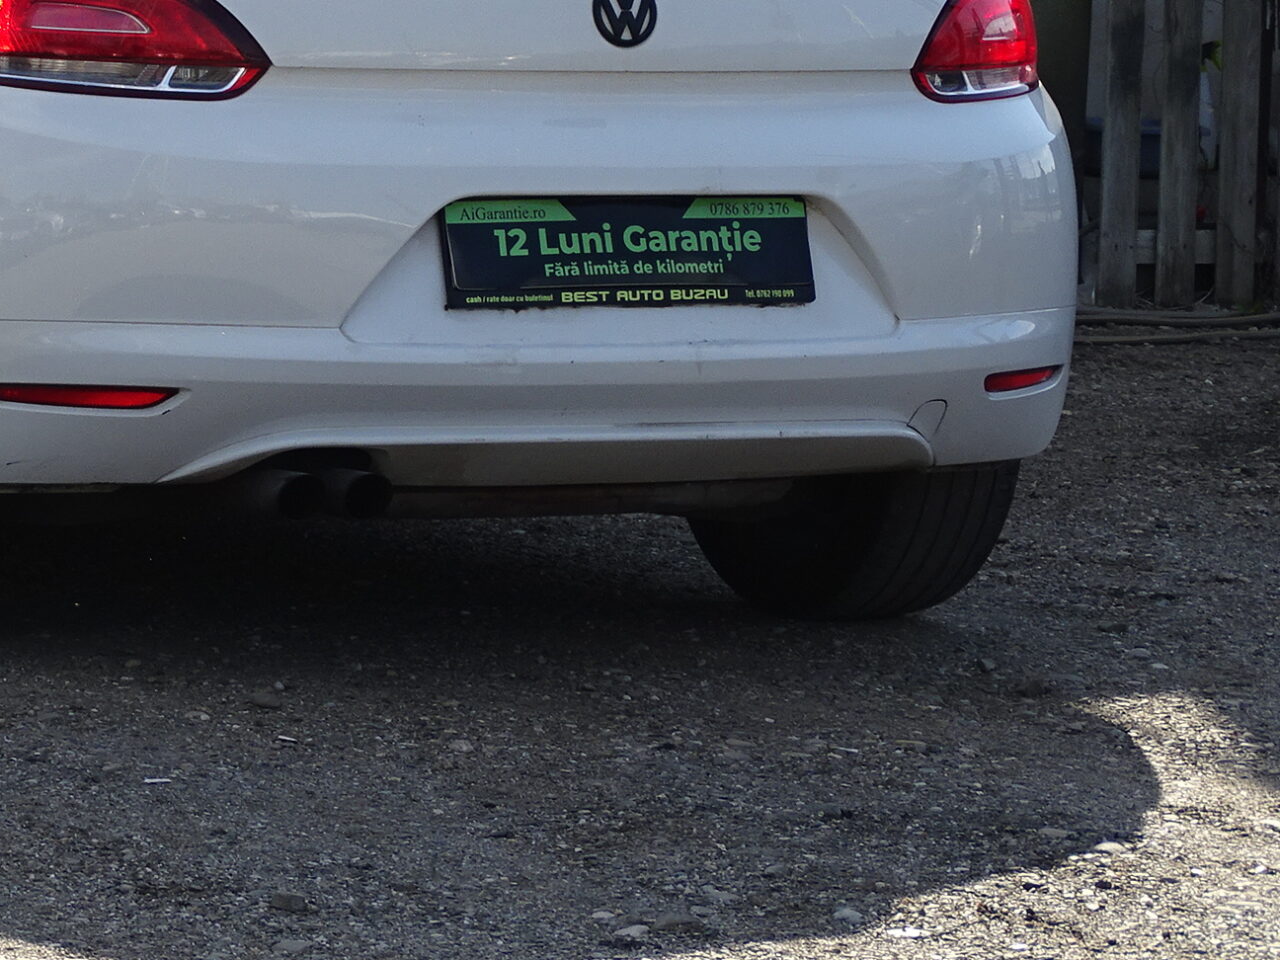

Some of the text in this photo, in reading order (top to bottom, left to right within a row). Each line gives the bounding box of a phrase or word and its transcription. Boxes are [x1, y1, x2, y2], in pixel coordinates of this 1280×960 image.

[460, 207, 546, 221] AiGarantie.ro
[710, 202, 790, 215] 0786 879 376
[494, 228, 529, 256] 12
[538, 223, 614, 255] Luni
[544, 259, 724, 277] Fără limită de kilometri
[561, 289, 729, 302] BEST AUTO BUZAU
